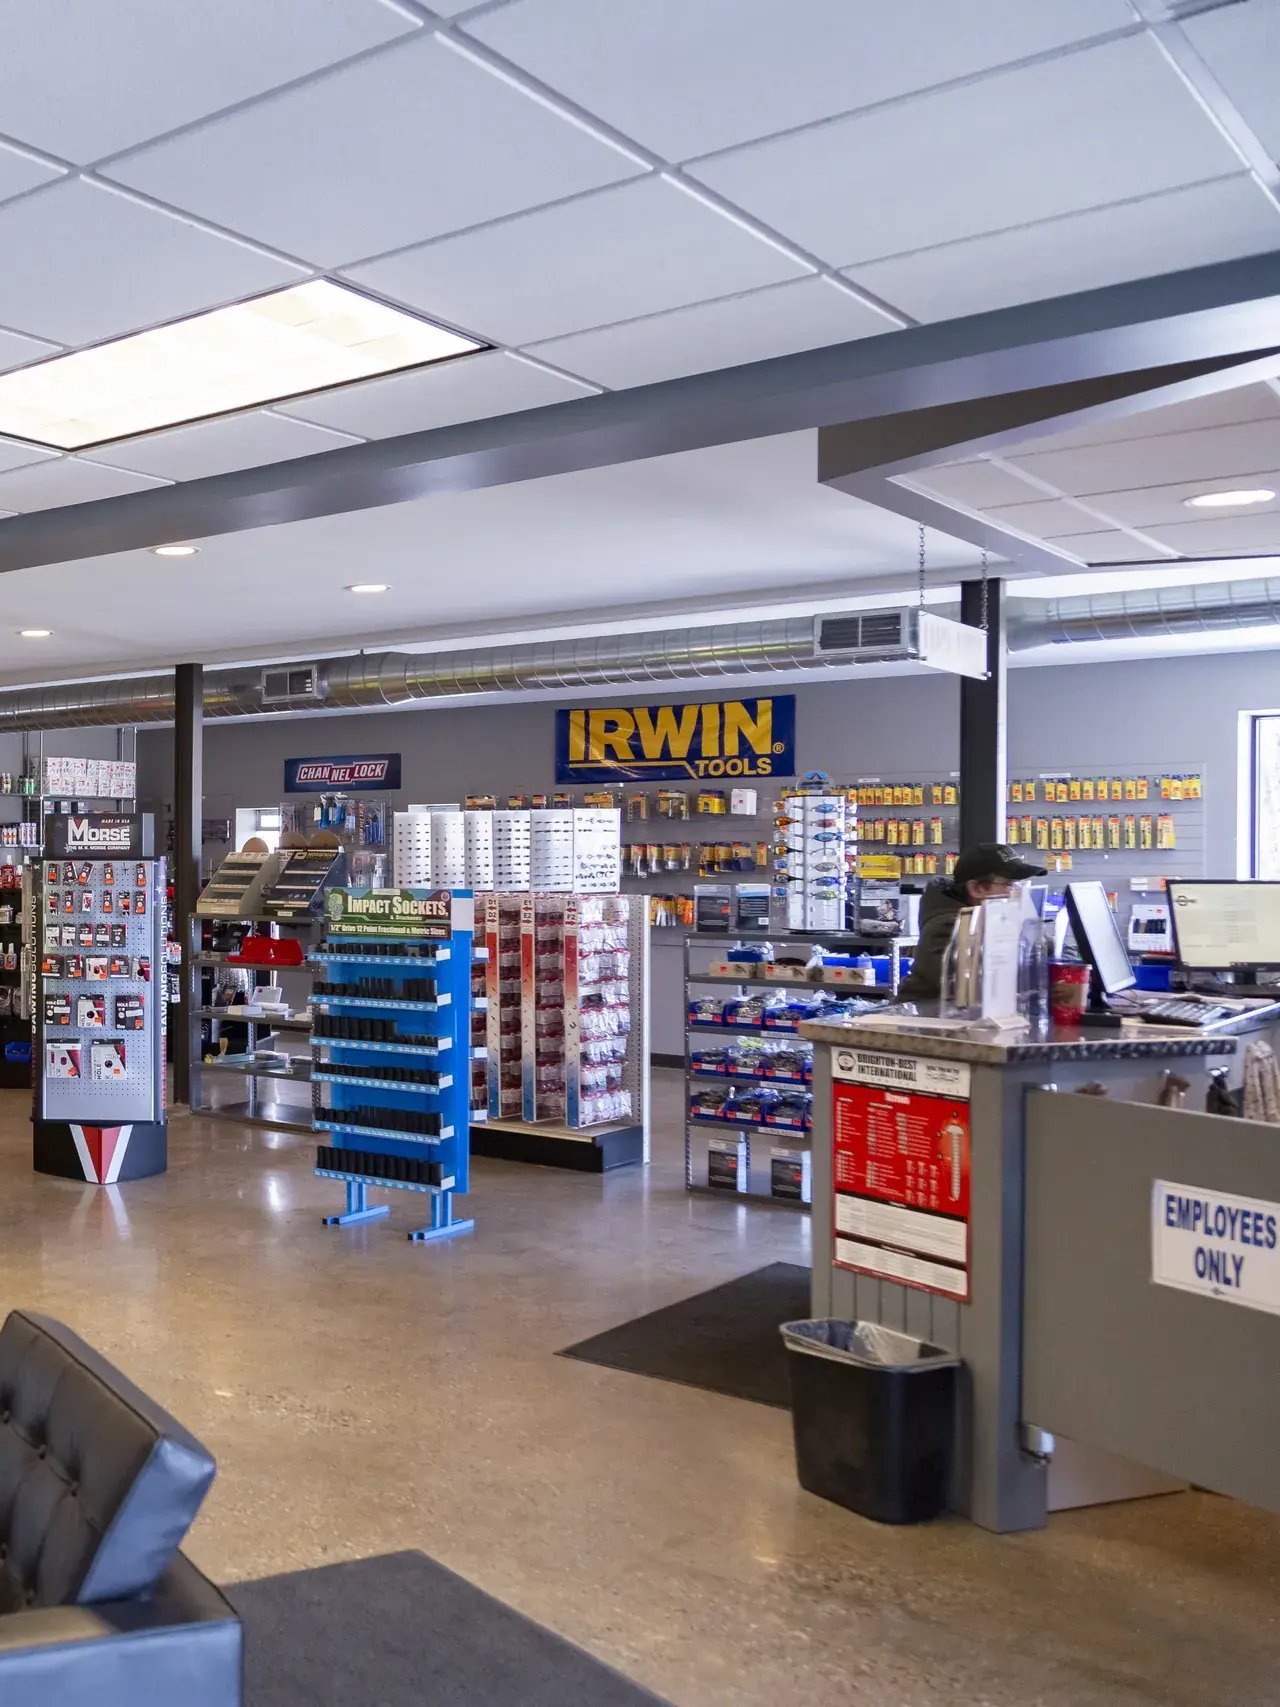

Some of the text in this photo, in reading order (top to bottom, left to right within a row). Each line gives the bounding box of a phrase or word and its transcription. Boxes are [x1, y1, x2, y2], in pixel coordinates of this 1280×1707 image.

[569, 699, 772, 761] IRWIN
[695, 758, 772, 777] TOOLS
[68, 818, 130, 843] MORSE
[347, 895, 449, 917] IMPACT SOCKETS,
[857, 1053, 917, 1070] BRIGHTON-BEST
[858, 1065, 917, 1082] INTERNATIONAL
[1166, 1194, 1277, 1249] EMPLOYEES
[1194, 1246, 1245, 1288] ONLY
